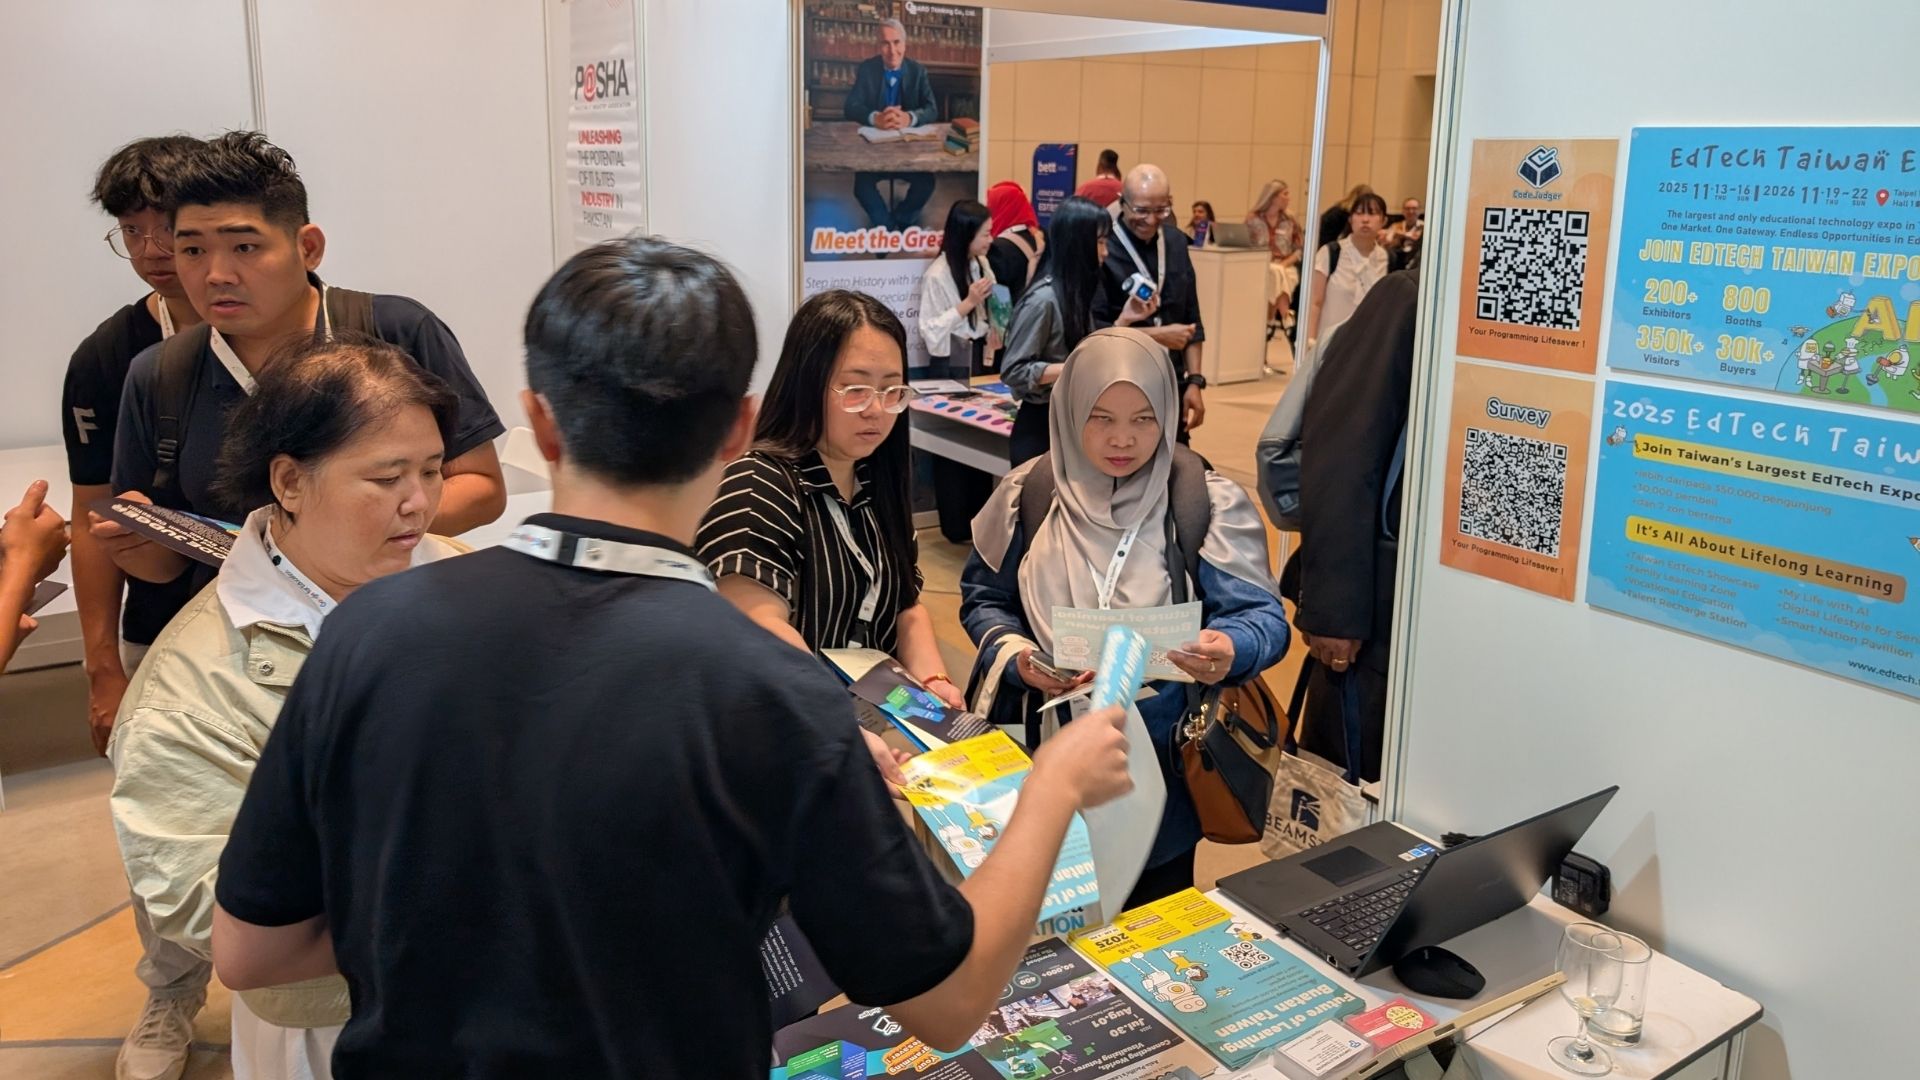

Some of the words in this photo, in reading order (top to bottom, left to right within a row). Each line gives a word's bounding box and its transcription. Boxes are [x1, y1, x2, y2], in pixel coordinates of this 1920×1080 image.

[578, 129, 622, 145] UNLEASHING
[590, 150, 626, 167] POTENTIAL
[1670, 144, 1766, 169] EdTech
[1778, 146, 1888, 172] Taiwan
[1901, 150, 1916, 172] E
[581, 191, 614, 208] INDUSTRY
[616, 194, 623, 209] IN
[1658, 182, 1688, 194] 2025
[1763, 185, 1795, 197] 2026
[584, 211, 613, 228] PAKISTAN
[1667, 210, 1682, 219] The
[1685, 211, 1716, 222] largest
[1719, 212, 1735, 221] and
[1738, 212, 1757, 224] only
[1760, 214, 1815, 225] educational
[1819, 217, 1874, 230] technology
[1878, 220, 1902, 231] expo
[1906, 220, 1915, 229] in
[813, 228, 866, 250] Meet
[869, 227, 900, 249] the
[1661, 222, 1678, 231] One
[1680, 224, 1712, 233] Market.
[1715, 225, 1733, 234] One
[1736, 226, 1777, 237] Gateway.
[1780, 229, 1818, 240] Endless
[1822, 231, 1891, 244] Opportunities
[1894, 234, 1904, 243] in
[1639, 239, 1684, 262] JOIN
[1690, 242, 1764, 269] EDTECH
[1772, 247, 1855, 275] TAIWAN
[806, 278, 829, 290] Step
[852, 276, 886, 289] History
[889, 276, 909, 285] with
[1644, 278, 1698, 305] 200+
[1723, 285, 1770, 313] 800
[1642, 307, 1691, 320] Exhibitors
[1725, 315, 1762, 328] Booths
[1468, 326, 1486, 336] Your
[1489, 329, 1538, 343] Programming
[1541, 336, 1580, 348] Lifesaver
[1643, 354, 1679, 367] Visitors
[1720, 363, 1756, 376] Buyers
[1487, 398, 1549, 426] Survey
[72, 406, 100, 444] F
[1613, 400, 1675, 425] 2025
[1687, 408, 1809, 446] EdTech
[1828, 427, 1920, 465] Taiw
[1642, 442, 1673, 456] Join
[1677, 448, 1742, 468] Taiwan's
[1747, 460, 1807, 481] Largest
[1812, 471, 1873, 493] EdTech
[111, 504, 188, 542] JUDGER
[186, 540, 228, 559] ODE
[1452, 538, 1469, 550] Your
[1472, 544, 1519, 564] Programming
[1522, 557, 1558, 573] Lifesaver
[1636, 523, 1659, 539] It's
[1664, 530, 1683, 545] All
[1688, 535, 1735, 557] About
[1741, 547, 1808, 576] Lifelong
[1815, 564, 1894, 596] Learning
[1664, 570, 1708, 591] Learning
[1710, 585, 1737, 598] Zone
[1626, 589, 1656, 605] Talent
[1659, 596, 1706, 617] Recharge
[1710, 610, 1748, 629] Station
[1682, 588, 1734, 611] Education
[1826, 599, 1853, 612] with
[1780, 617, 1815, 633] Smart
[1819, 626, 1857, 644] Nation
[1783, 602, 1819, 618] Digital
[1823, 612, 1872, 632] Lifestyle
[1875, 626, 1892, 637] for
[1060, 888, 1076, 904] of
[1095, 933, 1129, 949] 2025
[1274, 984, 1334, 1012] Buatan
[1306, 992, 1356, 1017] Future
[1091, 1007, 1132, 1028] Aug.01
[1109, 1018, 1144, 1037] Jul.30
[1214, 1009, 1279, 1038] Taiwan
[1289, 1014, 1307, 1028] of
[1220, 1021, 1292, 1053] Learning,
[1102, 1042, 1144, 1061] Visualizing
[1128, 1040, 1171, 1060] Connecting
[917, 1055, 939, 1070] Your
[1073, 1059, 1102, 1073] Futures
[1098, 1057, 1130, 1070] Worlds,
